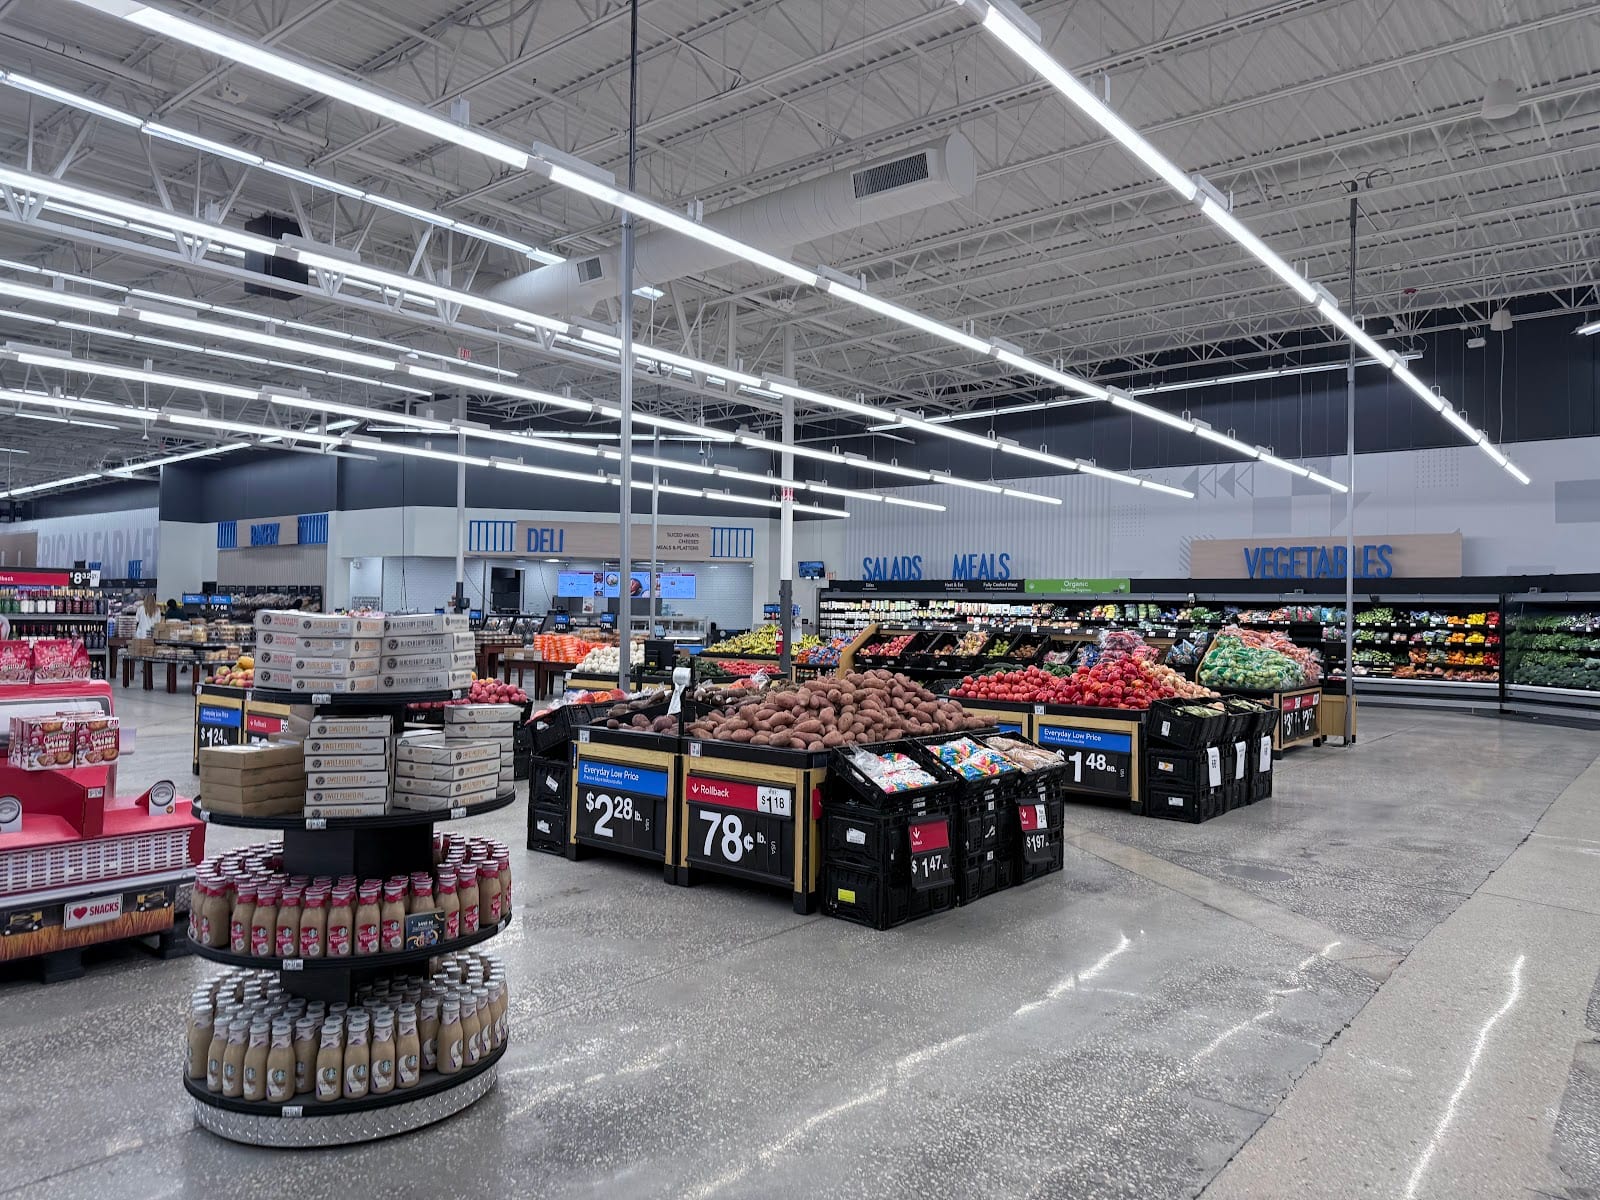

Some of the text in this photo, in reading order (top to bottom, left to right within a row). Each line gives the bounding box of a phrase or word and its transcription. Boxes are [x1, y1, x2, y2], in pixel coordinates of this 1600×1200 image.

[251, 522, 280, 547] BAKERY
[527, 527, 564, 553] DELI
[862, 553, 1010, 581] SALADS MEALS
[1243, 544, 1393, 579] VEGETABLES
[1063, 580, 1089, 588] Organic
[65, 721, 74, 729] 20
[92, 736, 116, 747] MINI
[1044, 728, 1072, 739] Everyday
[1072, 731, 1085, 739] Low
[1086, 733, 1102, 742] Price
[45, 739, 70, 749] MINI
[583, 764, 610, 778] Everyday
[611, 768, 622, 778] Low
[624, 770, 639, 781] Price
[700, 784, 729, 798] Rollback
[89, 902, 119, 916] SNACKS
